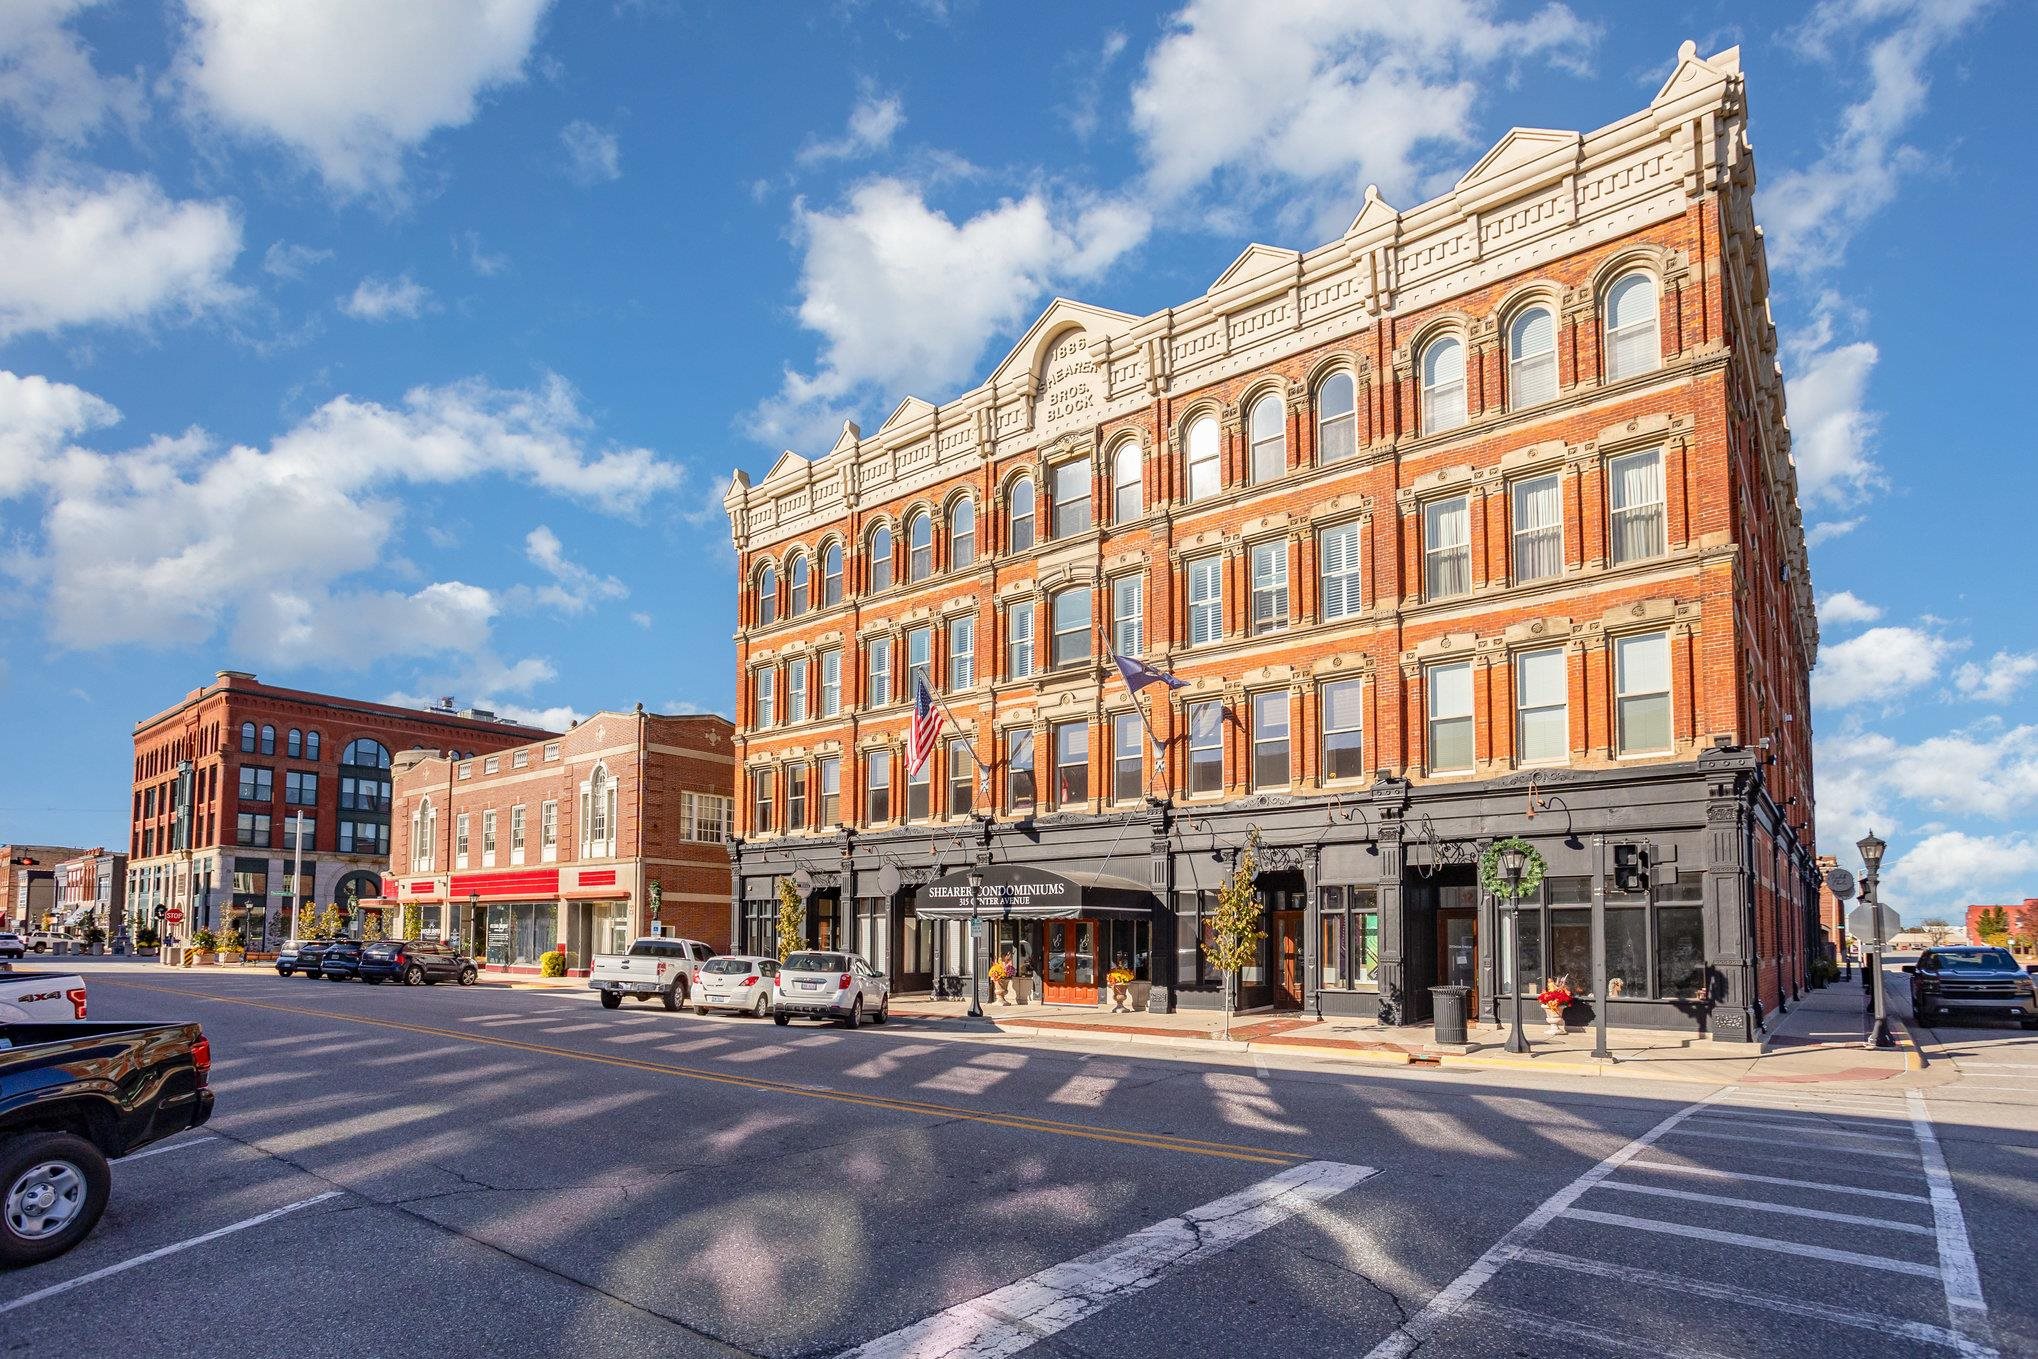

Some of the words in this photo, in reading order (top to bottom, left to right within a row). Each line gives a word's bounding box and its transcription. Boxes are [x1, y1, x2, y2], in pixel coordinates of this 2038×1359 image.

[1038, 360, 1098, 395] SHEARER
[1049, 383, 1090, 406] BROS.
[1047, 394, 1094, 422] BLOCK
[929, 886, 974, 897] SHEARER
[959, 898, 969, 906] 315
[970, 897, 999, 905] CNTER
[1000, 896, 1030, 905] AVENUE
